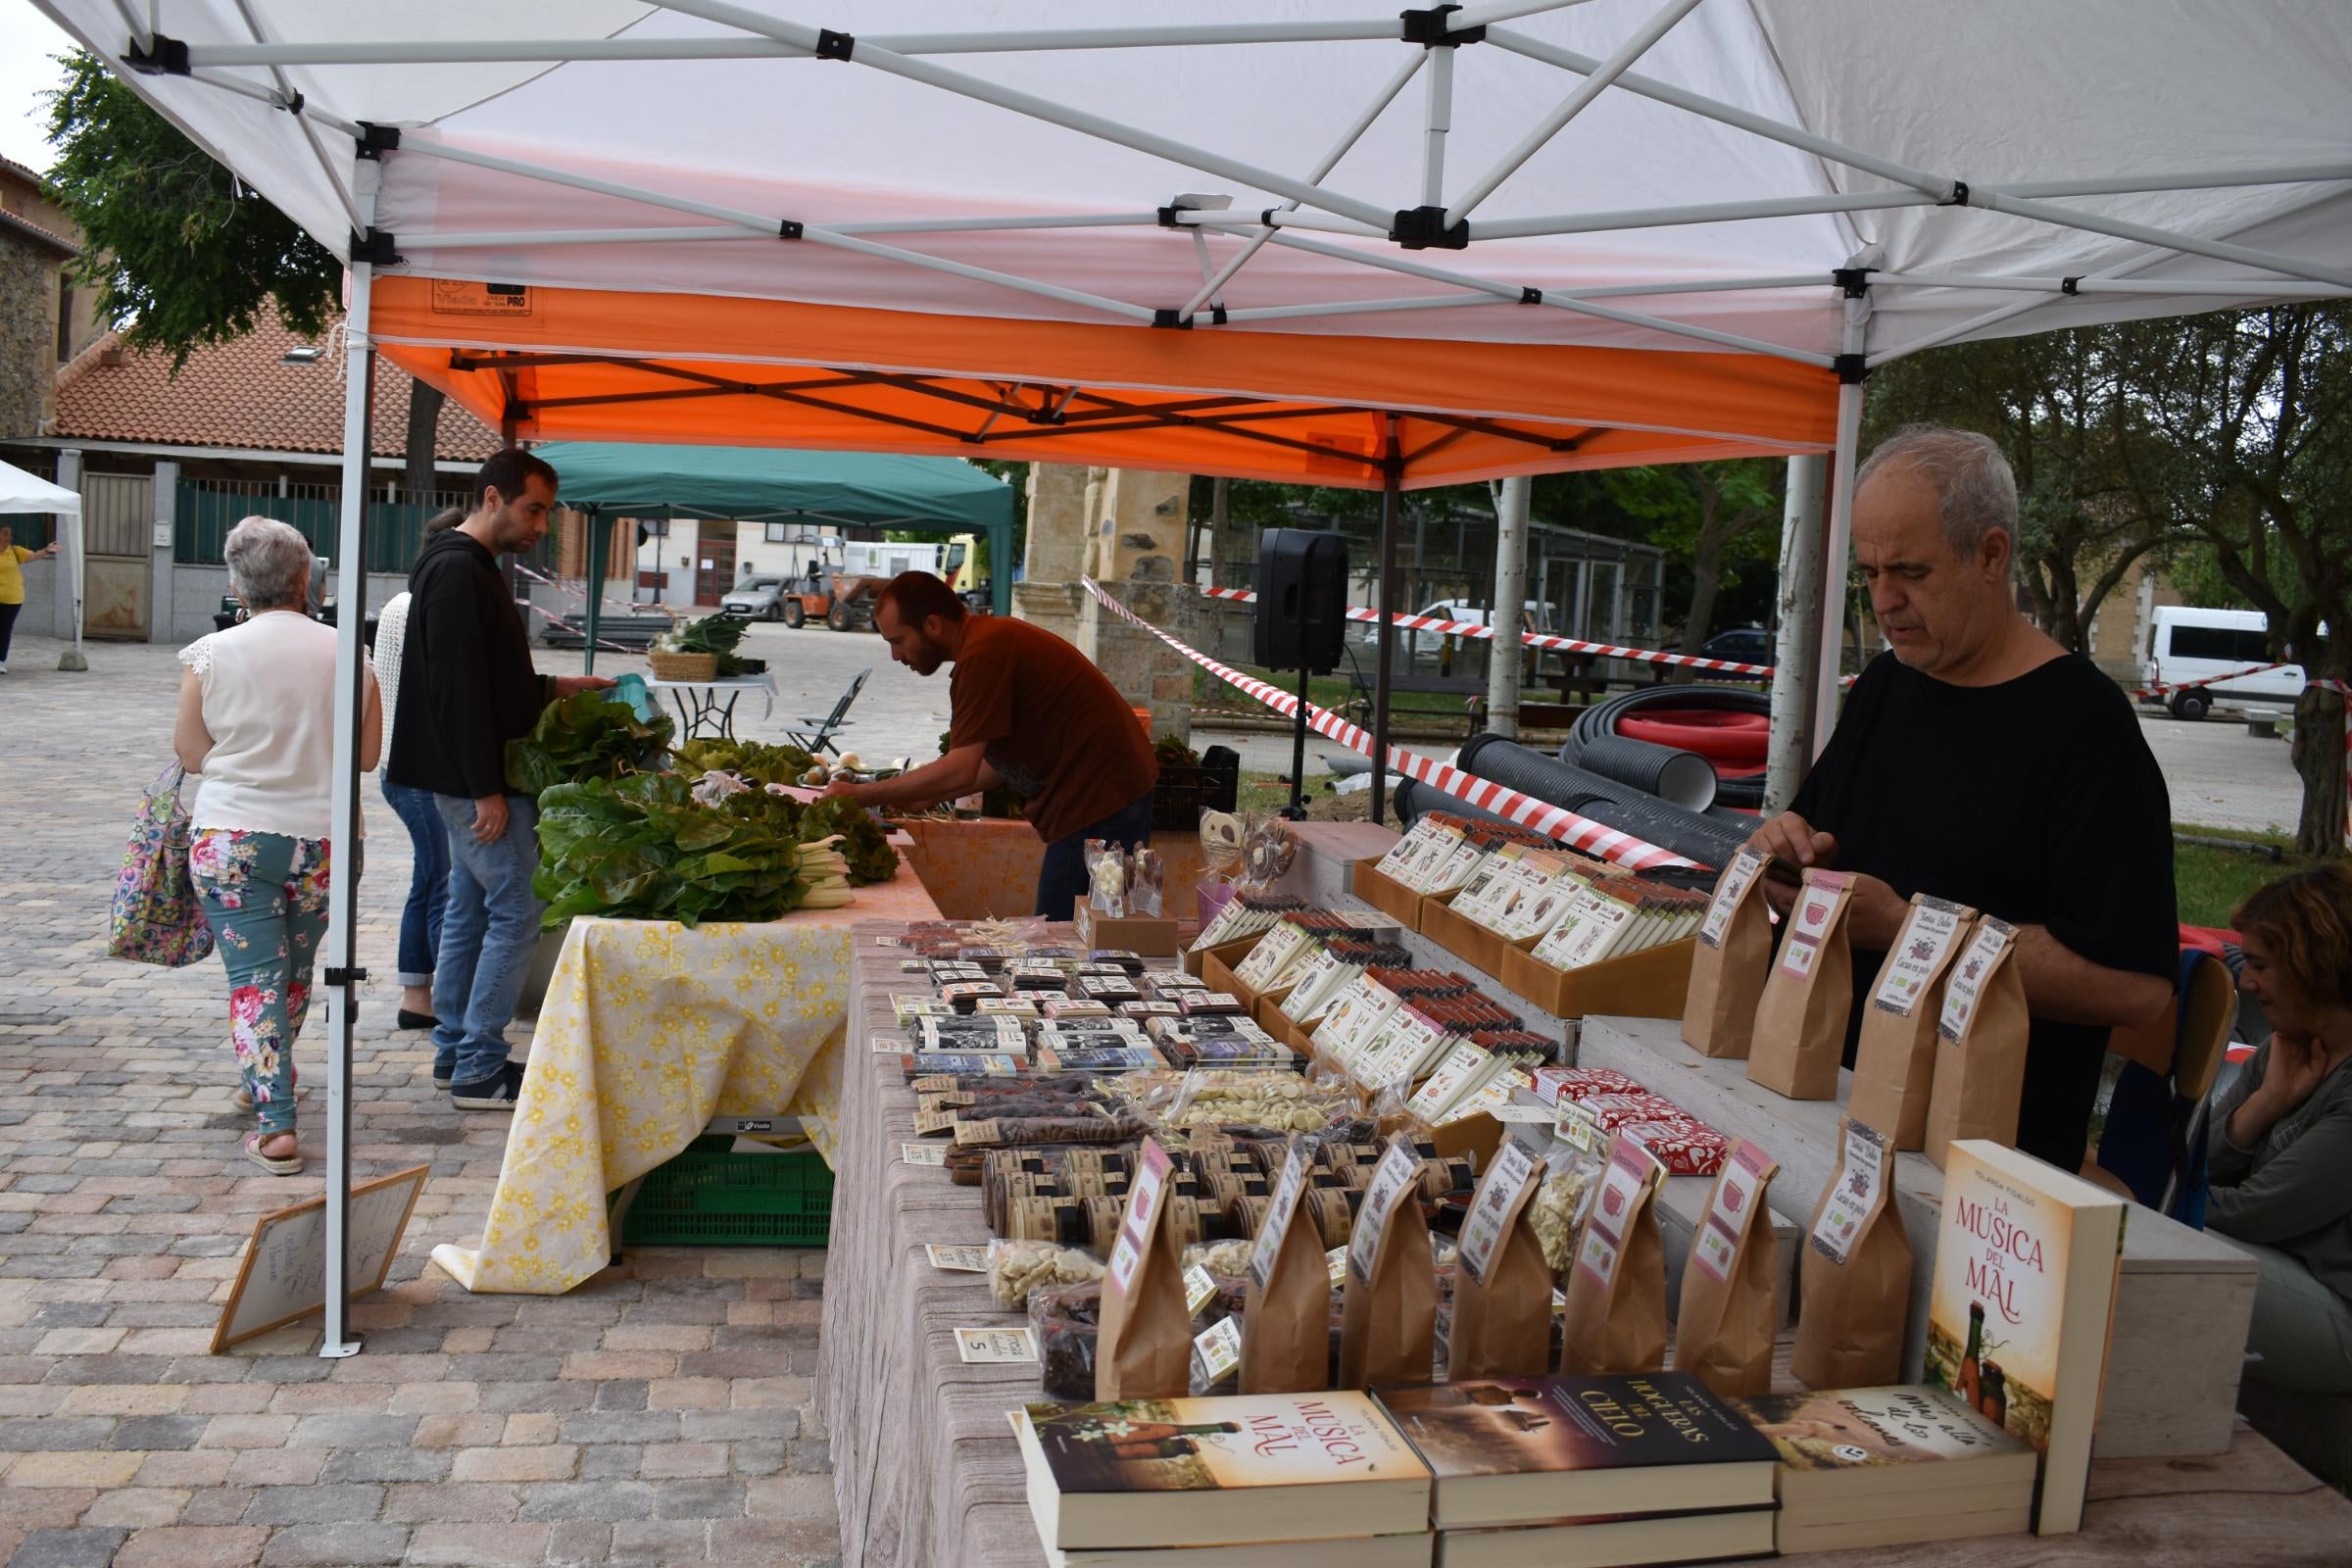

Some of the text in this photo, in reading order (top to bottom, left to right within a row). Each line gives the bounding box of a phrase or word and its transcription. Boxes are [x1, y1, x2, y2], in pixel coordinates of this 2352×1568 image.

[507, 296, 526, 308] PRO
[1975, 1169, 2036, 1207] YOLANDA FIDALGO
[1994, 1197, 2009, 1216] LA
[1955, 1196, 2044, 1273] MÚSICA
[1985, 1248, 2006, 1271] DEL
[1965, 1256, 2023, 1325] MAL
[970, 1341, 986, 1351] 5
[1580, 1390, 1644, 1438] CIELO
[1626, 1380, 1709, 1443] HOGUERAS
[1628, 1403, 1651, 1417] DEL
[1678, 1400, 1703, 1416] LAS
[1292, 1425, 1311, 1442] DEL
[1293, 1401, 1366, 1466] MÚSICA
[1348, 1424, 1366, 1436] LA
[1837, 1400, 1907, 1446] volcanes
[1886, 1406, 1929, 1439] de los
[1938, 1424, 1992, 1447] allá
[1245, 1415, 1298, 1459] MAL
